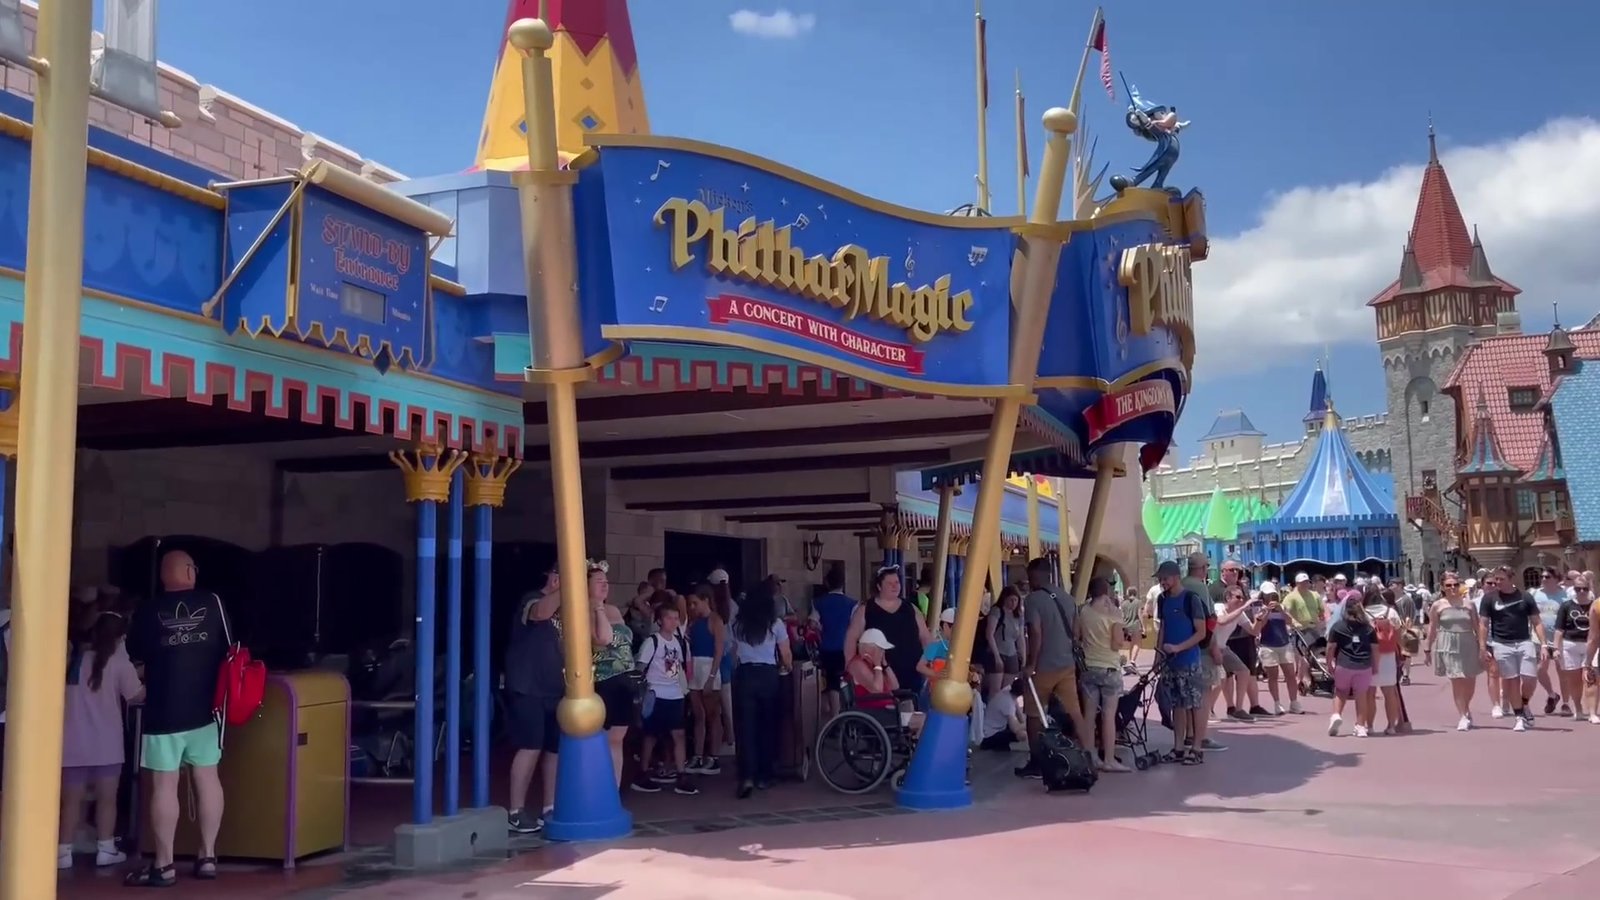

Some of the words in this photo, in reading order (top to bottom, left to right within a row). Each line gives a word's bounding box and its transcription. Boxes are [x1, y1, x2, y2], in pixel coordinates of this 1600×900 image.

[323, 216, 410, 273] STAND-BY
[335, 248, 398, 291] Entrance
[653, 197, 975, 342] PhilharMagic
[729, 300, 739, 315] A
[743, 302, 804, 330] CONCERT
[807, 319, 838, 342] WITH
[841, 332, 906, 363] CHARACTER
[1116, 393, 1133, 416] THE
